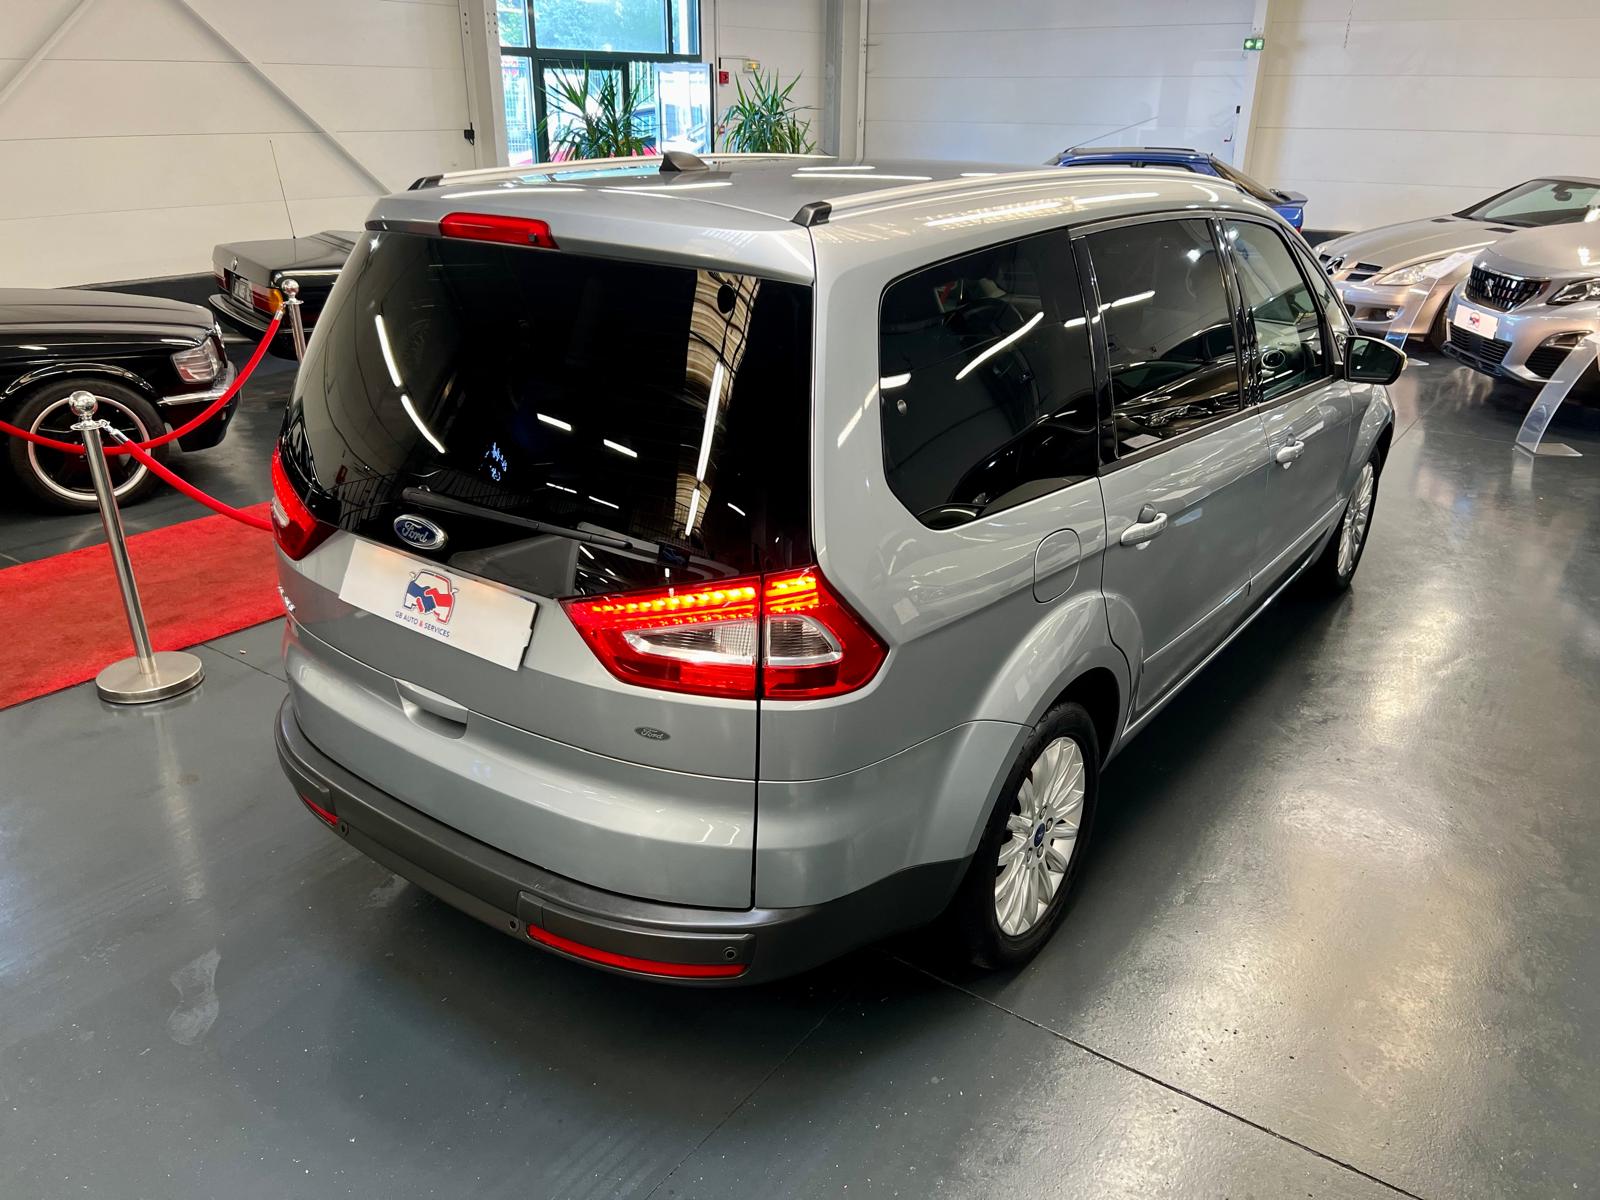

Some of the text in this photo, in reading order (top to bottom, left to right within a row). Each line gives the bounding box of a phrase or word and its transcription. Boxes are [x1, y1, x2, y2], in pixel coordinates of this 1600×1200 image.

[401, 520, 429, 543] Ford
[394, 610, 404, 619] GB
[403, 614, 419, 625] AUTO
[423, 622, 451, 638] SERVICES
[640, 728, 665, 740] Ford
